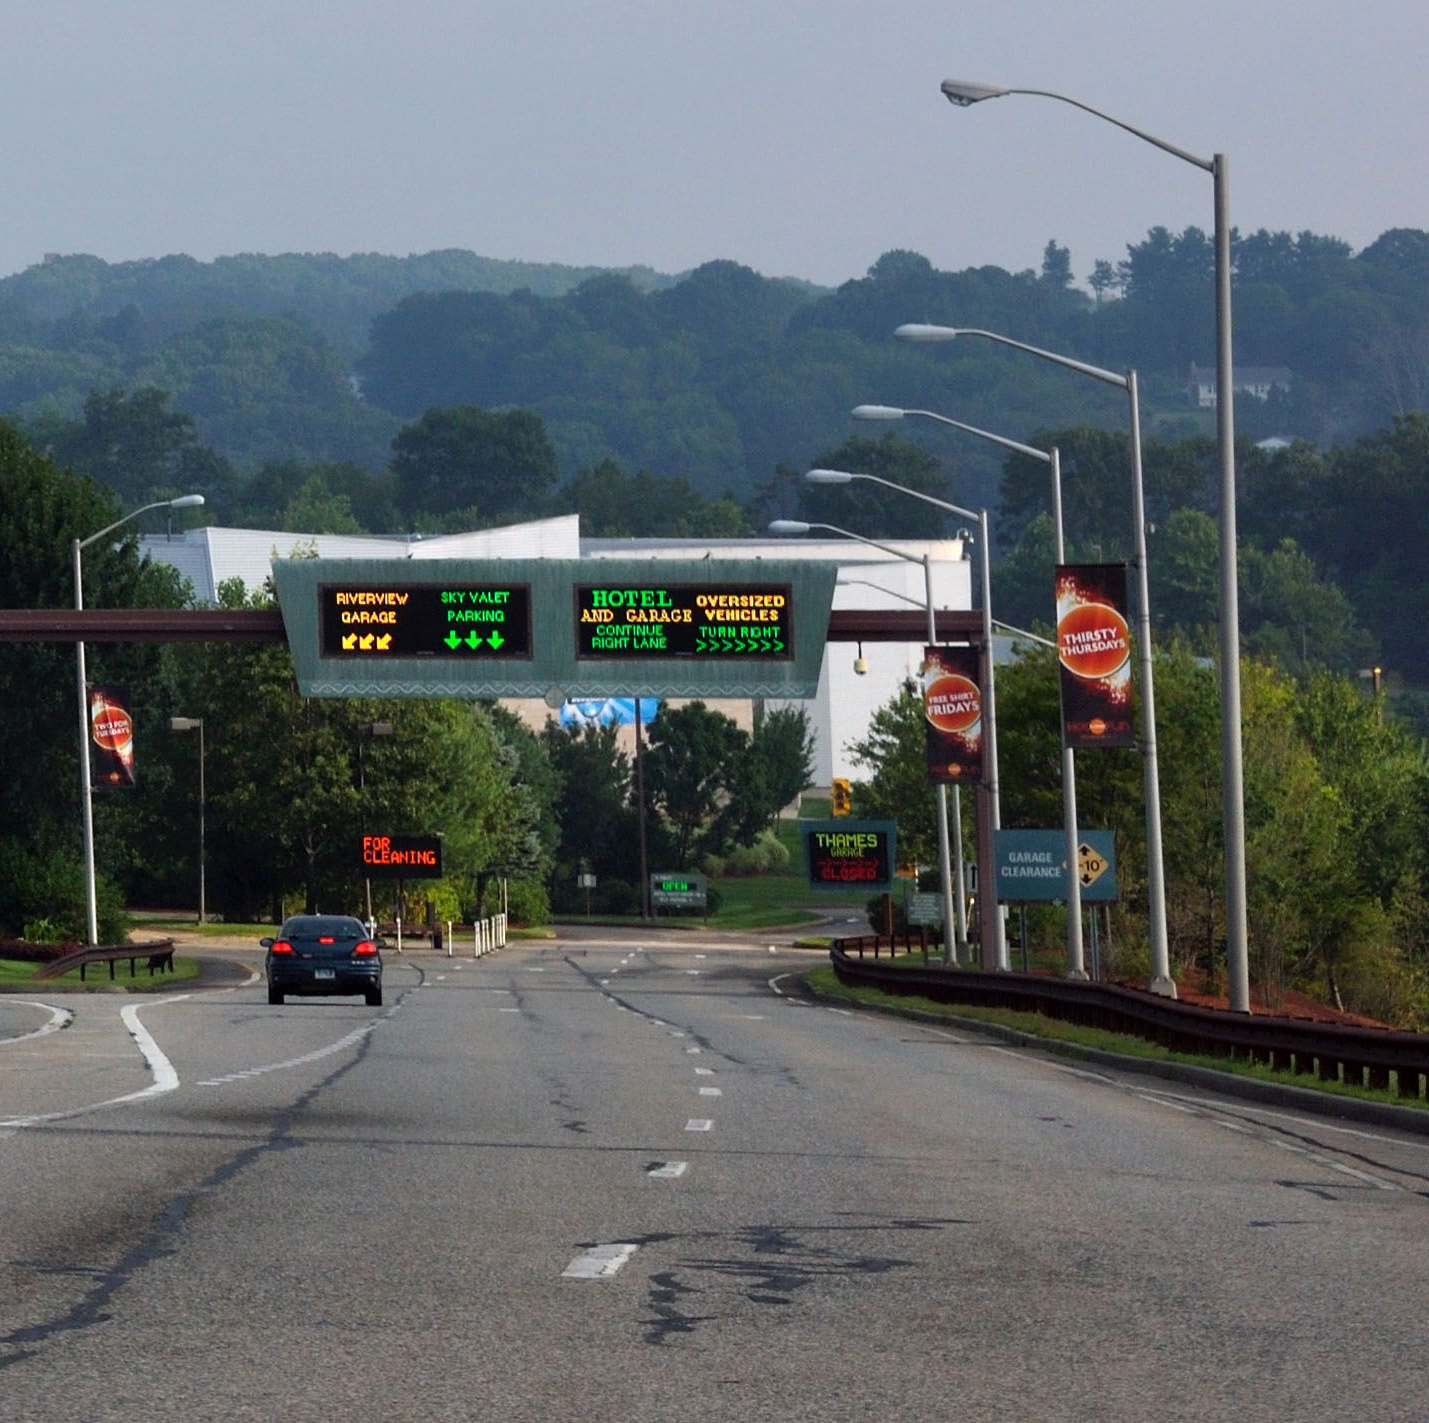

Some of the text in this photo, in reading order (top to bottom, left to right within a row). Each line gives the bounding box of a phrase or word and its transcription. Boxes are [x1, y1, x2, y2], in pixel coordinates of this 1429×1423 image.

[336, 592, 409, 605] RIVERVIEW
[441, 591, 510, 605] SKY VALET
[592, 590, 672, 607] HOTEL
[696, 594, 785, 608] OVERSIZED
[341, 611, 396, 624] GARAGE
[447, 610, 505, 622] PARKING
[580, 609, 692, 623] AND GARAGE
[705, 609, 779, 622] VEHICLES
[596, 625, 664, 636] CONTINUE
[699, 626, 781, 638] TURN RIGHT
[1063, 627, 1118, 646] THIRSTY
[592, 637, 667, 649] RIGHT LANE
[1060, 638, 1126, 657] THURSDAYS
[928, 691, 974, 705] FREE SHIRT
[927, 700, 980, 717] FRIDAYS
[363, 837, 390, 851] FOR
[815, 833, 879, 848] THAMES
[363, 850, 436, 865] CLEANING
[1008, 852, 1053, 863] GARAGE
[1001, 866, 1061, 877] CLEARANCE
